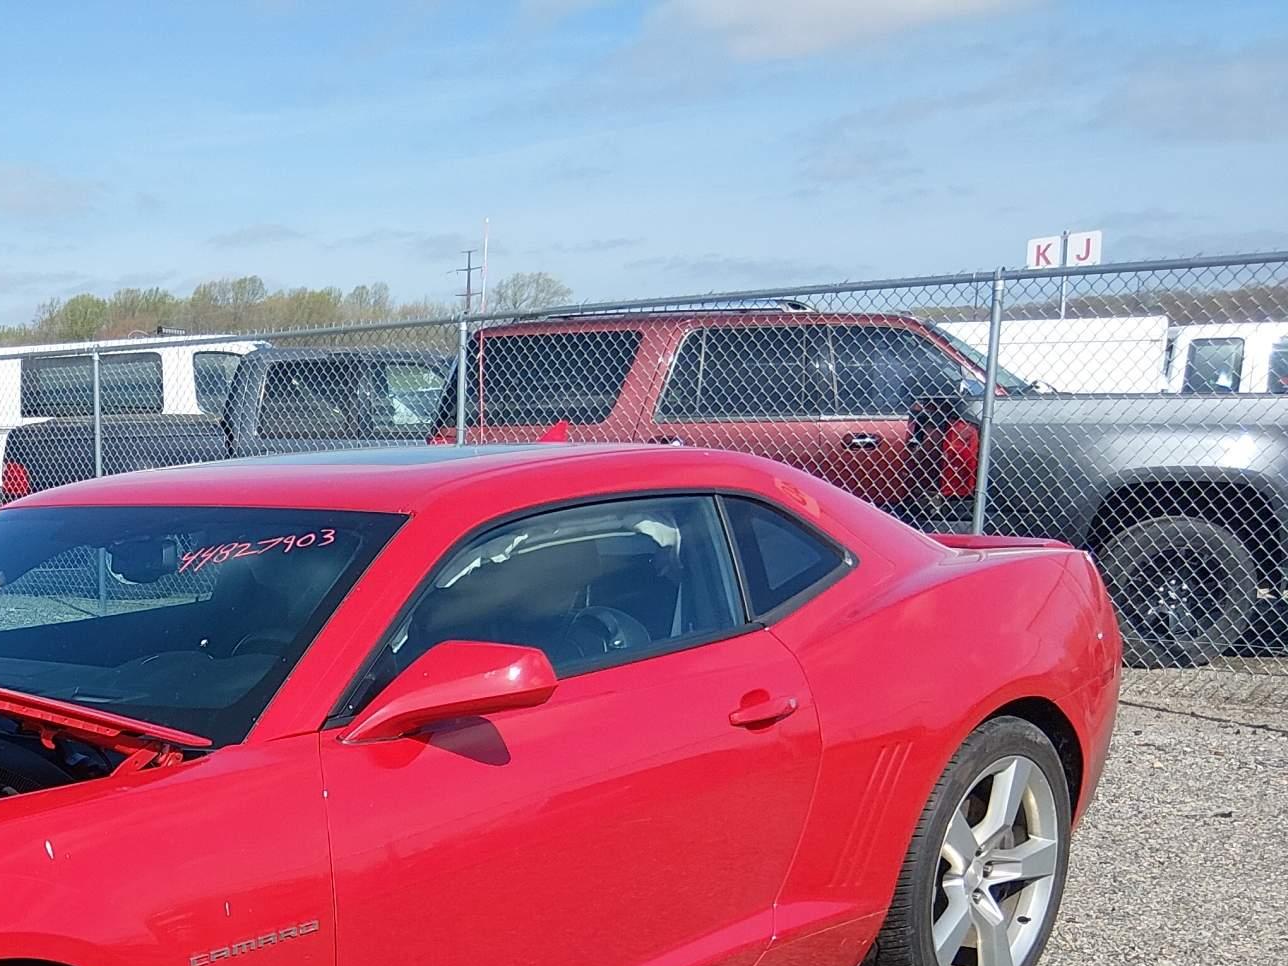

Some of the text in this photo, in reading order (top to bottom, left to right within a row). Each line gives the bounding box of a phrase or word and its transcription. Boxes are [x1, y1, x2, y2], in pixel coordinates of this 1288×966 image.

[1035, 243, 1053, 267] K
[1075, 238, 1091, 262] J
[178, 528, 336, 574] 44827903
